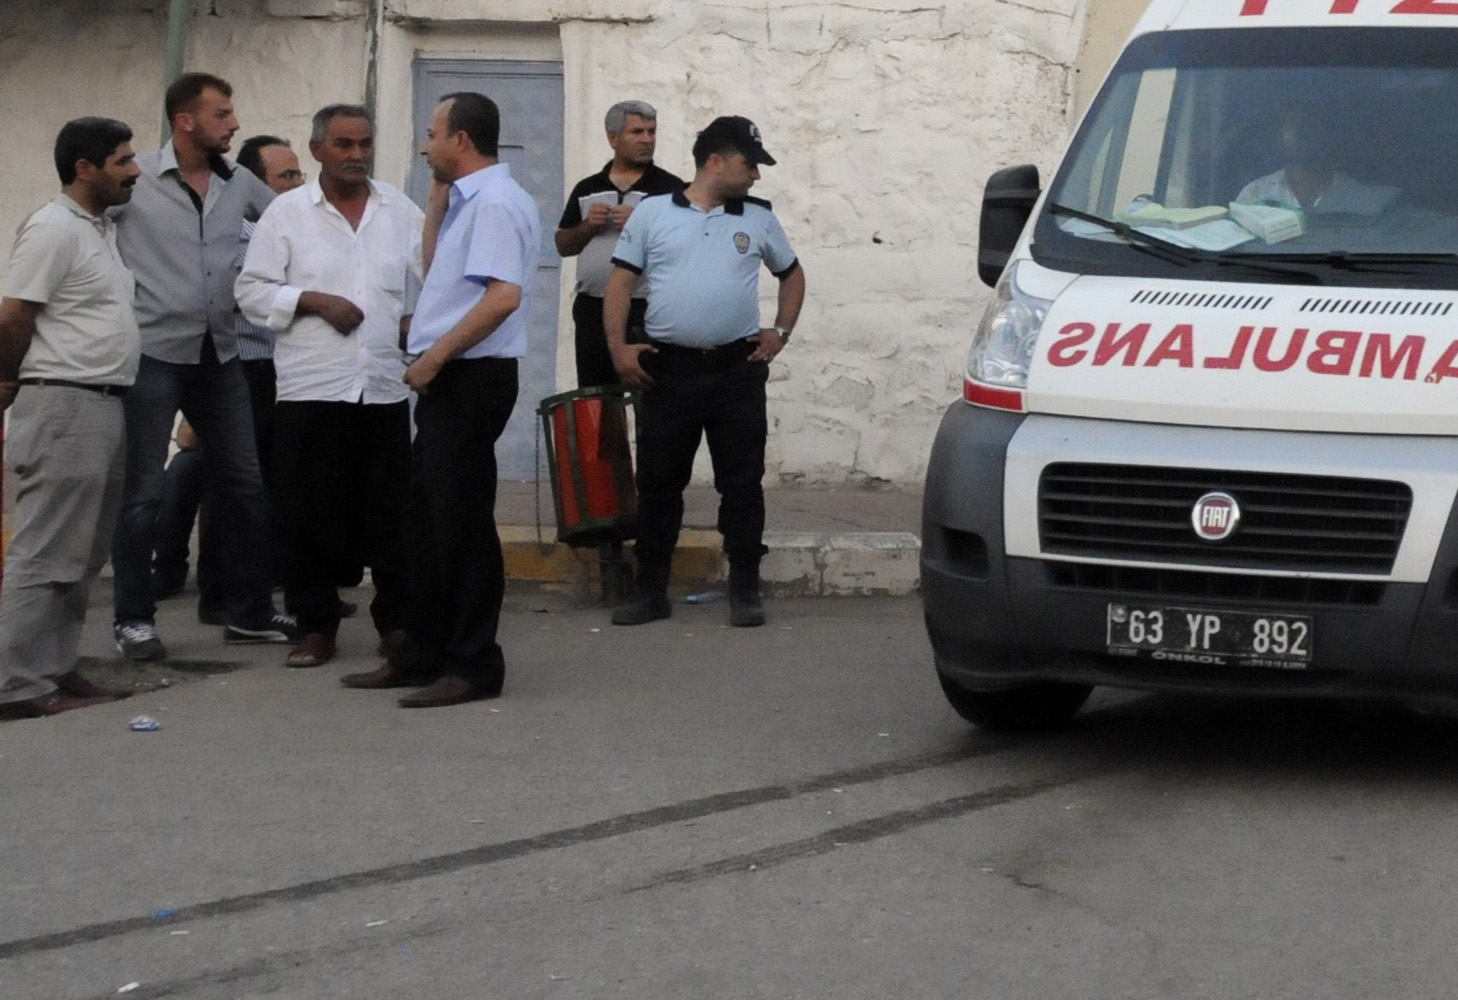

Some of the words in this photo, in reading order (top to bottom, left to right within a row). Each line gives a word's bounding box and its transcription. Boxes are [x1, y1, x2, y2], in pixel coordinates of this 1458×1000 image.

[1202, 505, 1230, 527] FIAT
[1128, 610, 1164, 644] 63
[1186, 613, 1221, 649] YP
[1252, 618, 1308, 655] 892
